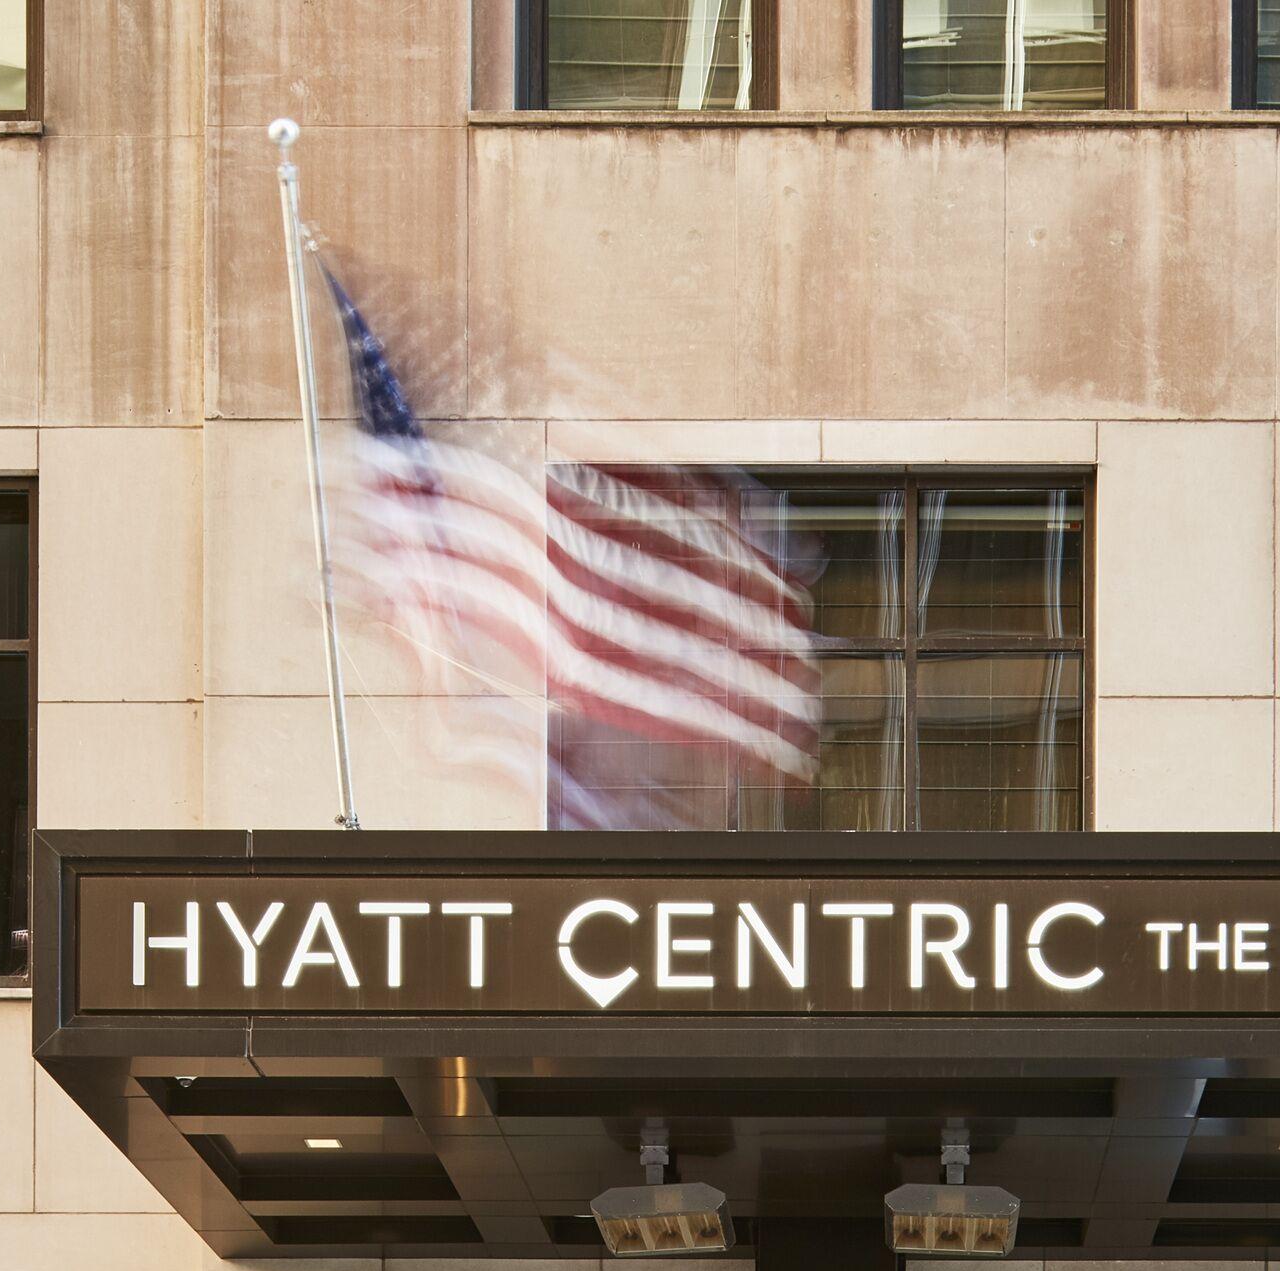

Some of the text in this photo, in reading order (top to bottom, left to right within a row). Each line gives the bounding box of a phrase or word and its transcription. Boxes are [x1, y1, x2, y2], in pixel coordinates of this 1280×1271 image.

[133, 902, 512, 988] HYATT
[558, 898, 1105, 1008] CENTRIC
[1146, 922, 1270, 971] THE
